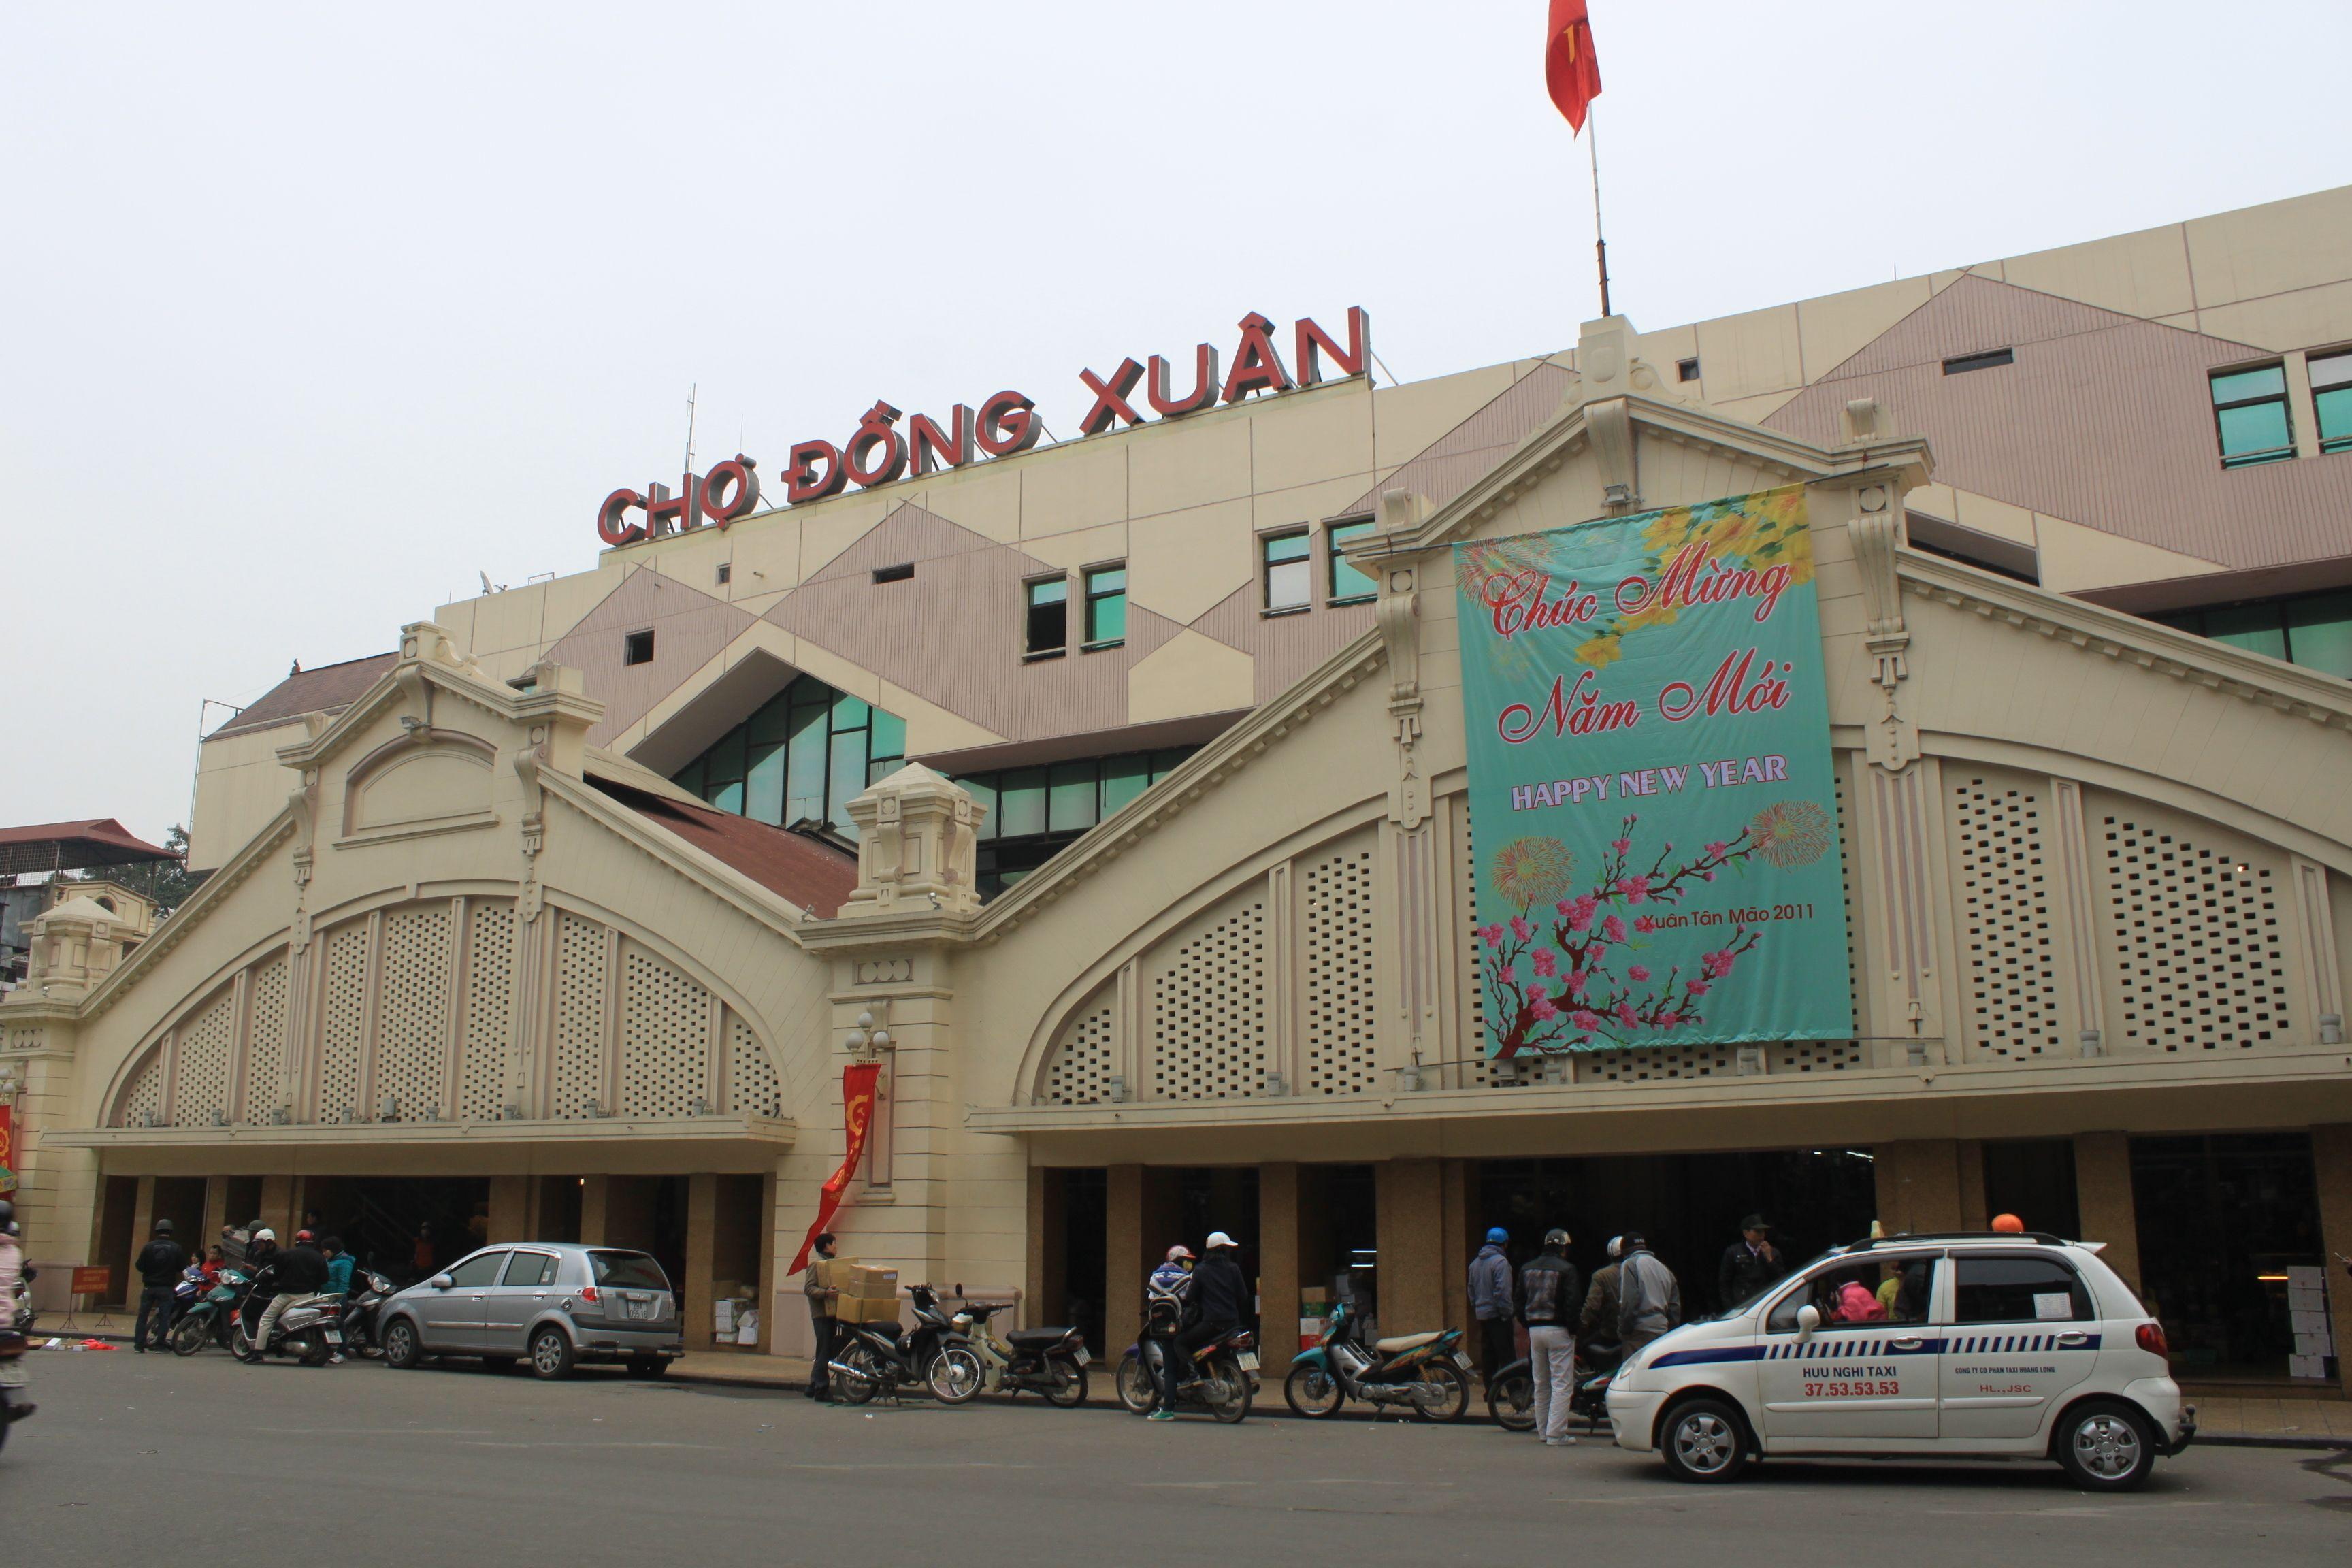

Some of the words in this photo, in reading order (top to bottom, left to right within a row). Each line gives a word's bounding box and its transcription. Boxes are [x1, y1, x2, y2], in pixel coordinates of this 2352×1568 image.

[598, 453, 760, 546] CHỢ
[781, 390, 1042, 504] ĐỒNG
[1079, 306, 1370, 436] XUÂN
[1482, 569, 1597, 640] Chúc
[1615, 540, 1791, 622] Mừng
[1499, 670, 1640, 743] Năm
[1659, 647, 1793, 721] Mới
[1512, 774, 1612, 811] HAPPY
[1620, 765, 1689, 798] NEW
[1698, 755, 1788, 788] YEAR
[1642, 913, 1688, 929] Xuân
[1691, 911, 1722, 926] Tân
[1729, 906, 1769, 924] Mão
[1773, 904, 1812, 920] 2011
[1803, 1367, 1829, 1378] HUU
[1833, 1366, 1863, 1377] NGHI
[1867, 1365, 1897, 1377] TAXI
[1804, 1381, 1899, 1396] 37.53.53.53
[2006, 1366, 2019, 1374] TAXI
